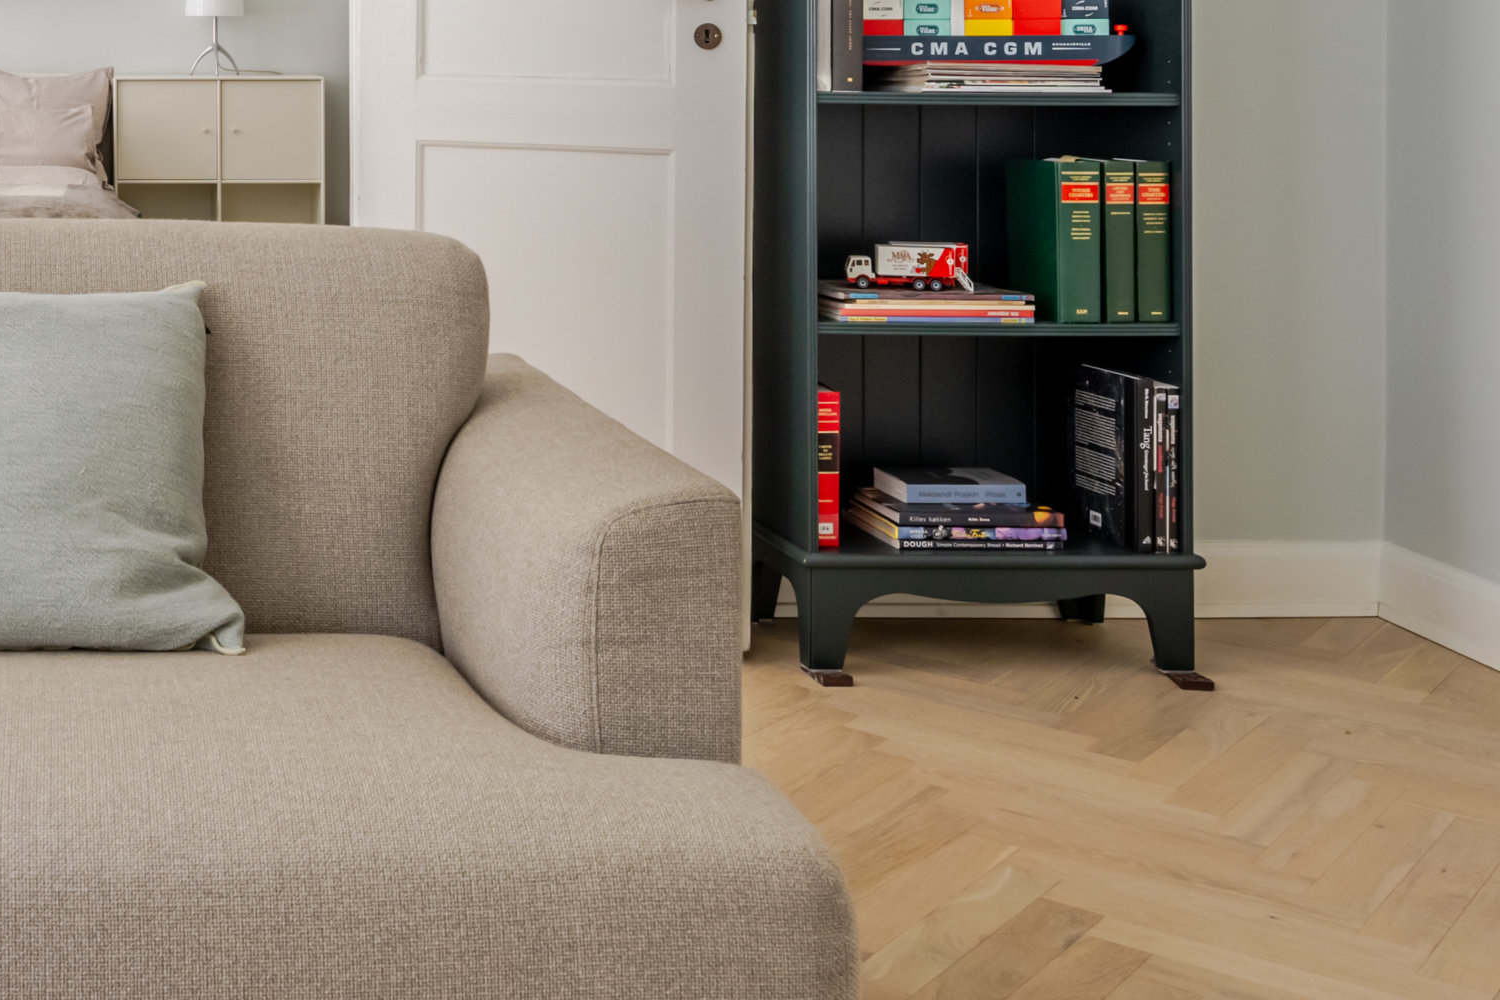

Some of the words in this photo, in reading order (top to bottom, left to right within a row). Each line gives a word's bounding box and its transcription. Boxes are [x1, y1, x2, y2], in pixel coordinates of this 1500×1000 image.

[918, 4, 935, 12] Vilac
[981, 4, 998, 12] Vilac
[919, 26, 936, 34] Vilac
[911, 42, 969, 56] CMA
[984, 41, 1042, 56] CGM
[1139, 426, 1153, 450] Tang
[954, 491, 979, 499] Pusjkin
[903, 540, 934, 548] DOUGH
[936, 541, 953, 549] Simple
[953, 541, 986, 549] Contemporary
[1005, 541, 1024, 549] Richard
